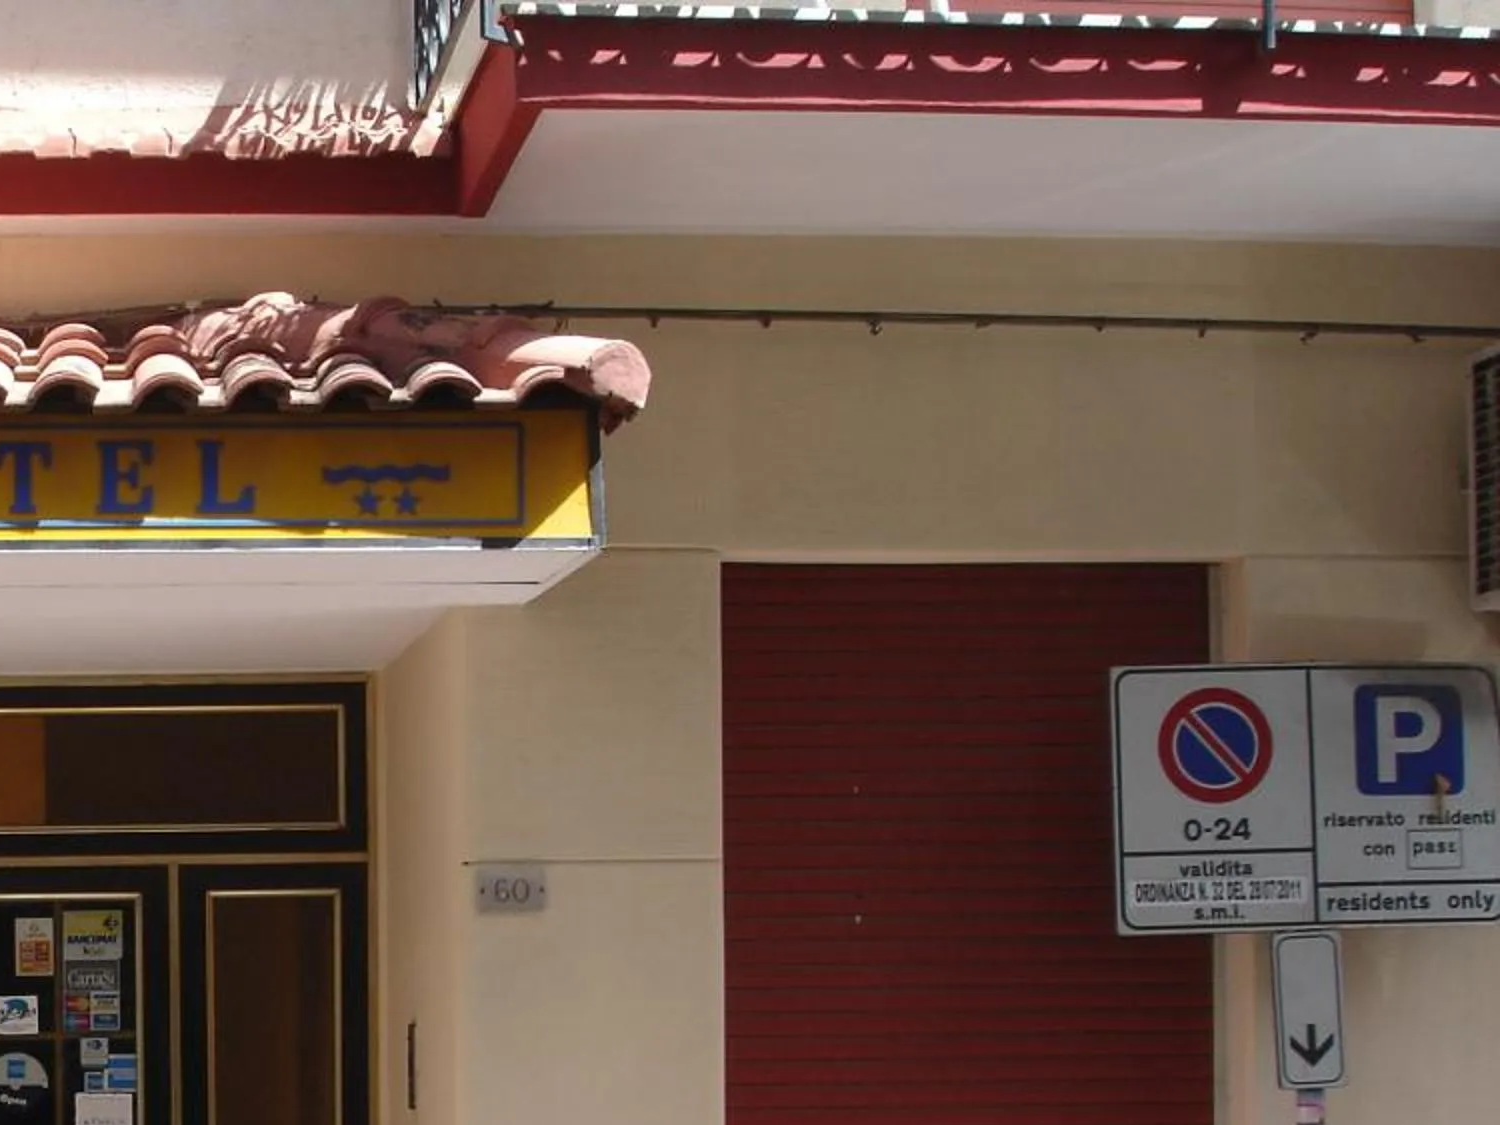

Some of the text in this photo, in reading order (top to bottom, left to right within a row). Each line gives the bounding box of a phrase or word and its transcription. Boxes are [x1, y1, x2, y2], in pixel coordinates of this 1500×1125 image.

[1375, 696, 1441, 783] P
[1183, 817, 1252, 841] 0-24
[1323, 811, 1405, 827] riservato
[1363, 843, 1395, 857] con
[493, 878, 531, 904] 60
[1327, 890, 1495, 914] residents only
